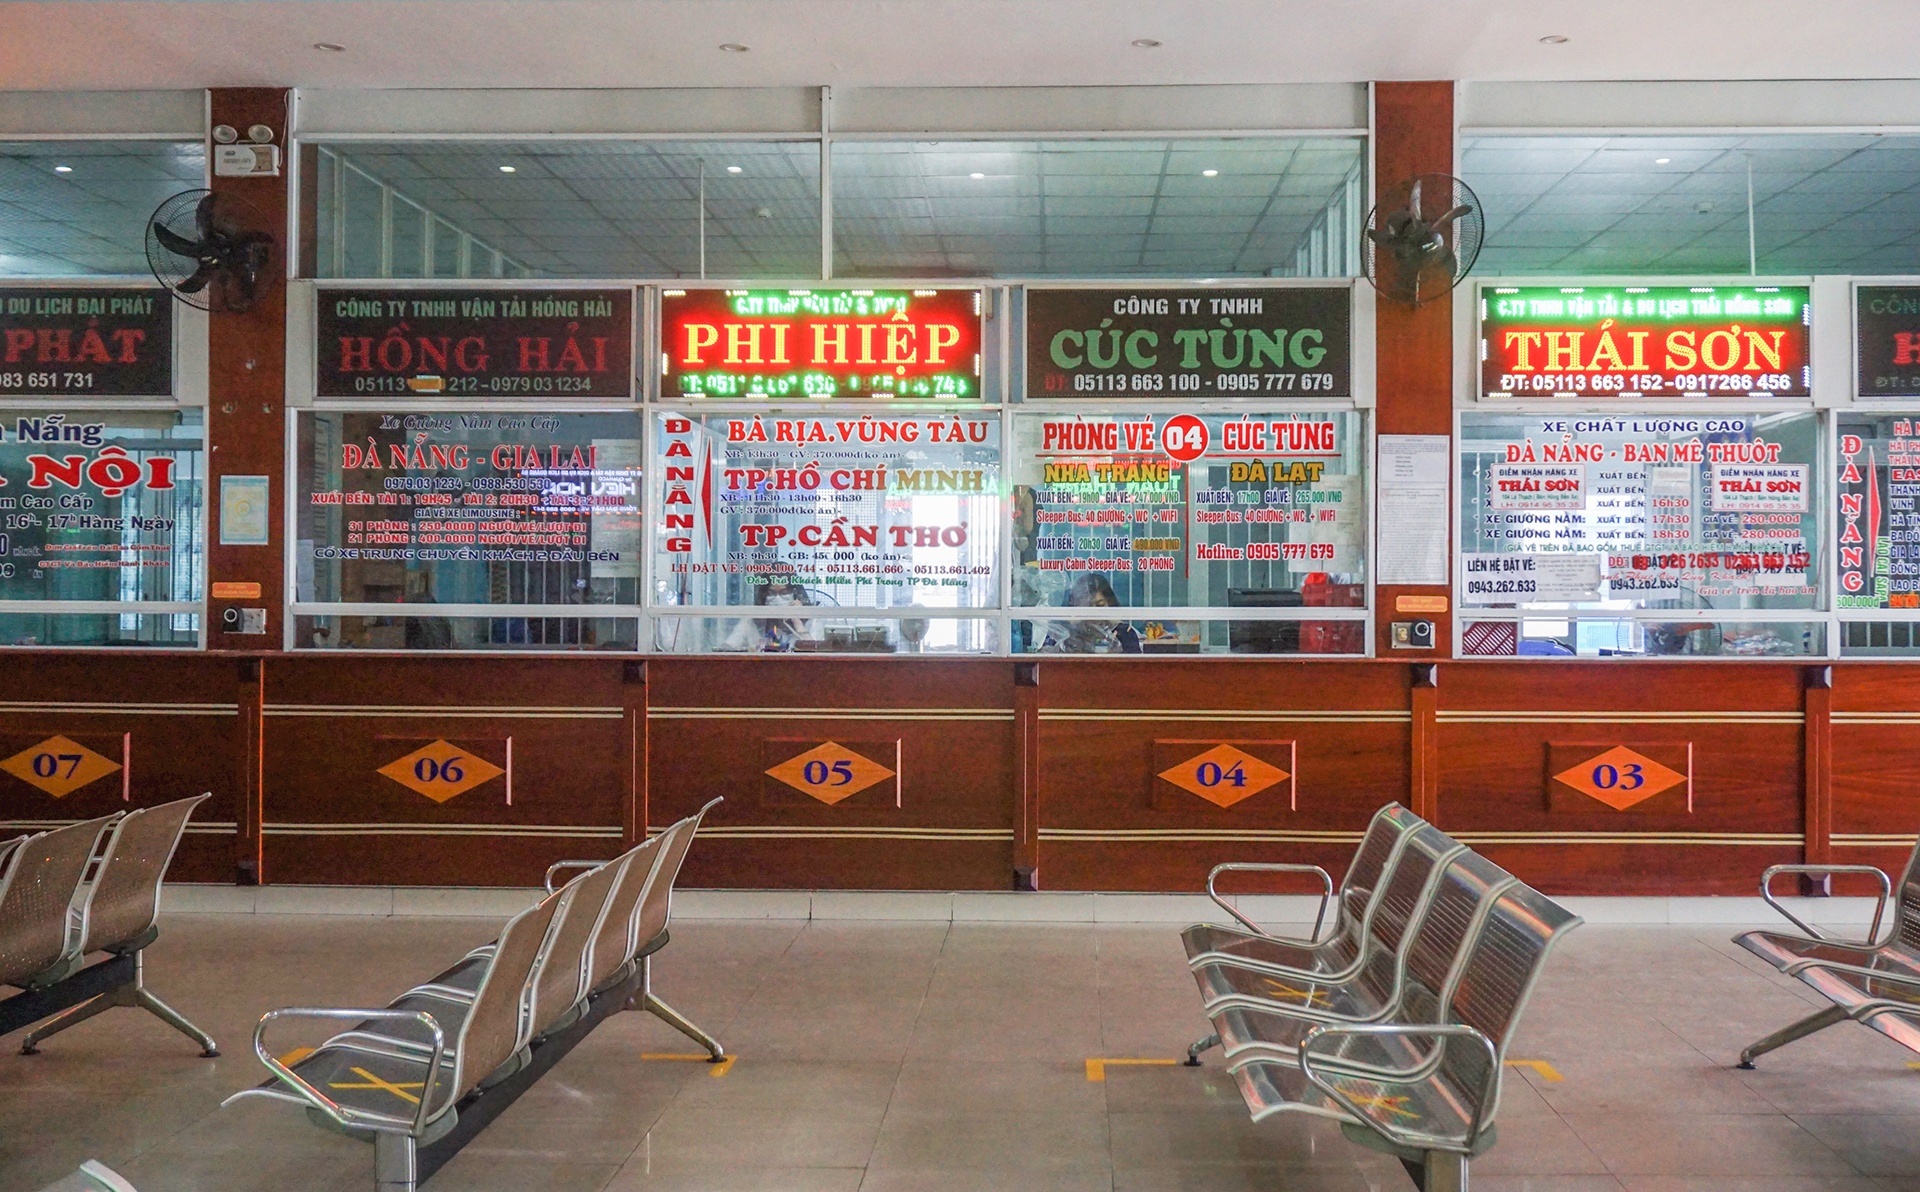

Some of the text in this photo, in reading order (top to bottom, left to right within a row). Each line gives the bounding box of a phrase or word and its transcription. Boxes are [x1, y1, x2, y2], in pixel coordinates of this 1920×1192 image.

[8, 295, 153, 318] DU LỊCH ĐẠI PHÁT
[336, 294, 612, 321] CÔNG TY TNHH VẬN TẢI HỒNG HẢI
[1113, 295, 1263, 315] CÔNG TY TNHH
[3, 320, 145, 363] PHÁT
[337, 322, 610, 373] HỒNG HẢI
[683, 311, 961, 376] PHI HIỆP
[1050, 318, 1328, 369] CÚC TÙNG
[1505, 319, 1786, 372] THÁI SƠN
[28, 373, 94, 387] 651 731
[355, 377, 405, 392] 05113
[449, 377, 478, 392] 212
[1074, 373, 1334, 391] 05113 663 100 0905 777 679
[1500, 374, 1790, 391] ĐT: 05113 663 456
[17, 414, 104, 446] Nẵng
[380, 414, 400, 430] Xe
[498, 416, 526, 430] Cao
[530, 414, 560, 432] Cấp
[727, 414, 768, 443] BÀ
[927, 415, 988, 443] TÀU
[1043, 413, 1335, 451] PHÒNG VÉ 04 CÚC TÙNG
[1542, 416, 1745, 435] XE CHẤT LƯỢNG CAO
[342, 432, 597, 470] ĐÀ NẴNG GIA LAI
[1506, 434, 1702, 463] ĐÀ NẴNG BAN MÊ
[27, 447, 176, 497] NỘI
[724, 460, 821, 491] TP.HỒ
[830, 464, 887, 491] CHÍ
[896, 469, 985, 491] MINH
[1044, 463, 1090, 483] NHA
[1095, 463, 1170, 483] TRANG
[1231, 458, 1325, 486] ĐÀ LẠT
[384, 477, 431, 490] 0979.03
[433, 477, 462, 490] 1234
[473, 478, 526, 491] 0988.530
[1498, 477, 1580, 492] THÁI SƠN
[1719, 478, 1801, 493] THÁI SƠN
[21, 492, 94, 511] Cao Cấp
[311, 489, 343, 505] XUẤT
[378, 490, 398, 505] TÀI
[414, 494, 452, 505] 19H45
[464, 491, 482, 505] TÀI
[500, 495, 539, 506] 20H30
[1265, 487, 1278, 504] GIÁ
[1891, 498, 1914, 510] VINH
[79, 514, 125, 531] Hàng
[131, 514, 175, 531] Ngày
[1485, 514, 1500, 524] XE
[1505, 512, 1551, 524] GIƯỜNG
[1652, 514, 1690, 524] 17h30
[1741, 513, 1801, 524] 280.000đ
[739, 516, 969, 548] TP.CẦN THƠ
[338, 548, 359, 559] XE
[361, 548, 415, 560] TRUNG
[482, 546, 533, 561] KHÁCH
[536, 551, 549, 561] 2
[1197, 543, 1335, 560] Hotline: 0905 777 679
[671, 563, 688, 573] LH
[692, 562, 718, 575] ĐẶT
[1467, 557, 1536, 574] LIÊN HỆ ĐẶT VÉ:
[1468, 580, 1537, 594] 0943.262.633
[32, 754, 83, 779] 07
[414, 756, 464, 782] 06
[803, 760, 853, 784] 05
[1196, 762, 1247, 787] 04
[1592, 764, 1644, 790] 03
